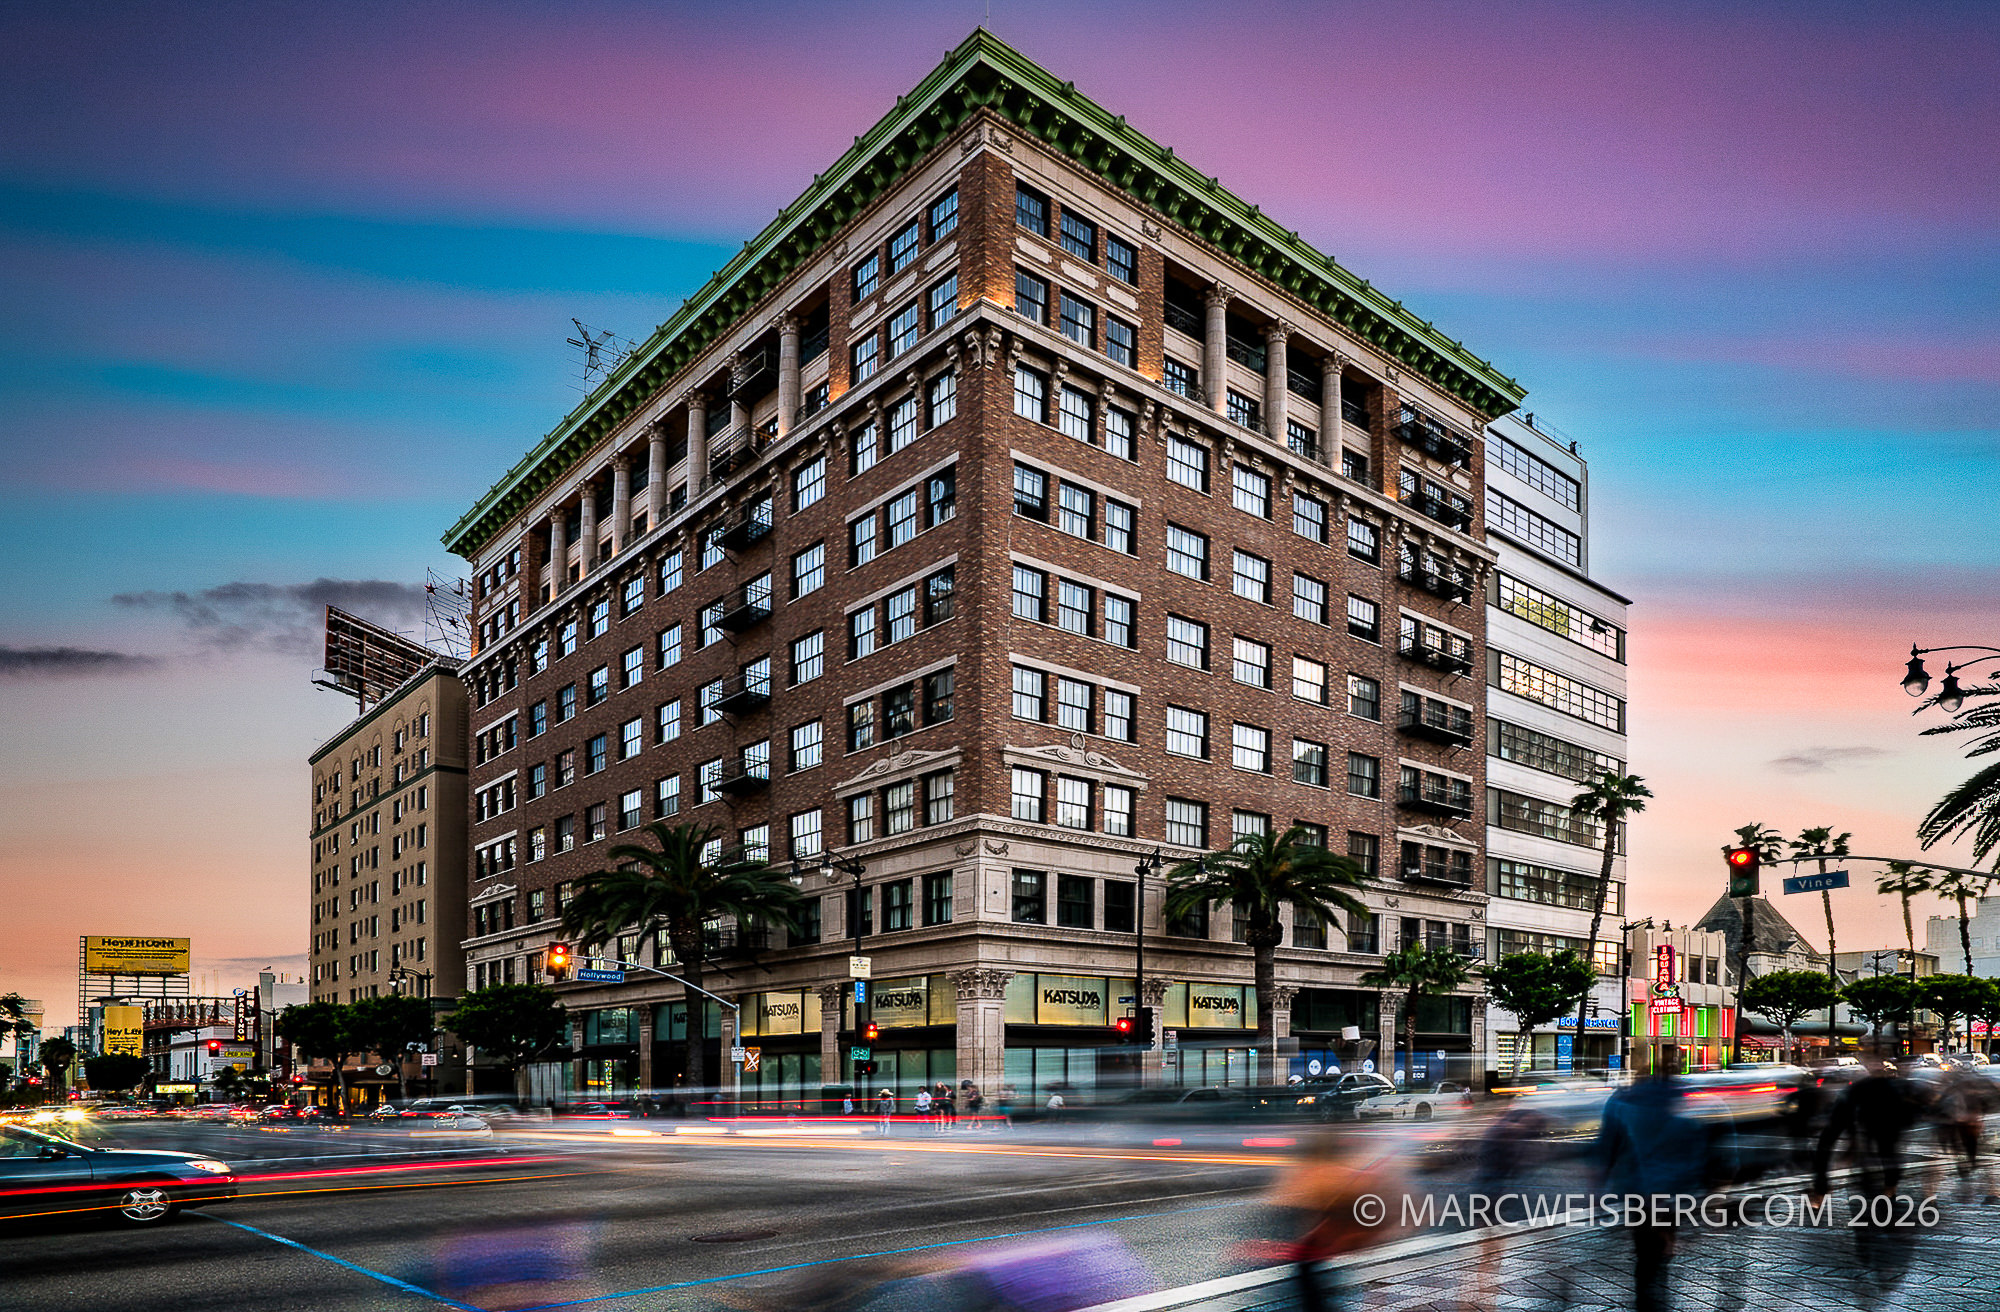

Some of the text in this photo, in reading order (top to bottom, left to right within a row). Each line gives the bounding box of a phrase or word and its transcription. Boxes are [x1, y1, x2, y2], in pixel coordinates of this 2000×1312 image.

[1798, 878, 1833, 889] Vine
[1659, 946, 1670, 991] IGUANA
[580, 972, 621, 980] Hollywood
[875, 992, 922, 1008] KATSUYA
[1044, 989, 1100, 1005] KATSUYA
[1192, 996, 1239, 1010] KATSUYA
[1654, 998, 1679, 1006] VINTAGE
[762, 1003, 799, 1017] KATSUYA
[1653, 1005, 1681, 1013] CLOTHING
